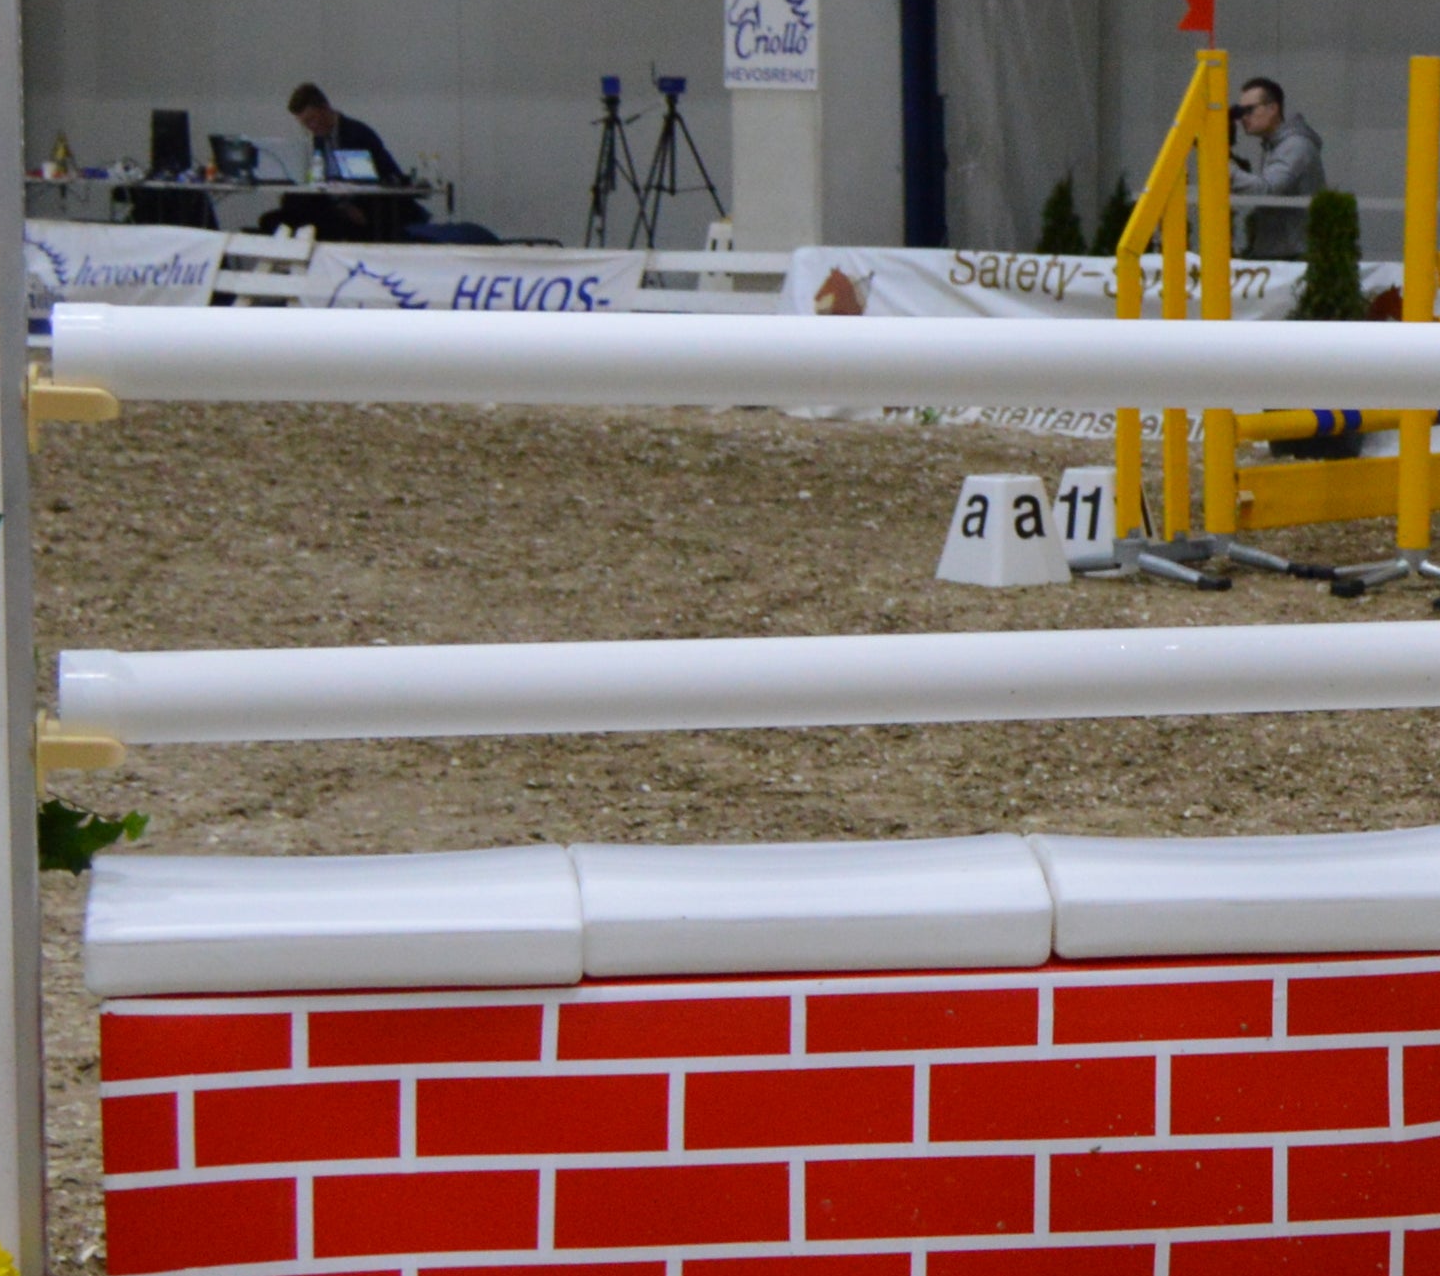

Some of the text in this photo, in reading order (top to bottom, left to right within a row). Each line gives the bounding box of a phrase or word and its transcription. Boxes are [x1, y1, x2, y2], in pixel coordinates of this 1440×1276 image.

[735, 20, 808, 59] Criollo
[725, 66, 815, 82] HEVOSREHUT
[962, 493, 989, 539] a
[1013, 493, 1046, 539] a
[1059, 486, 1102, 540] 11
